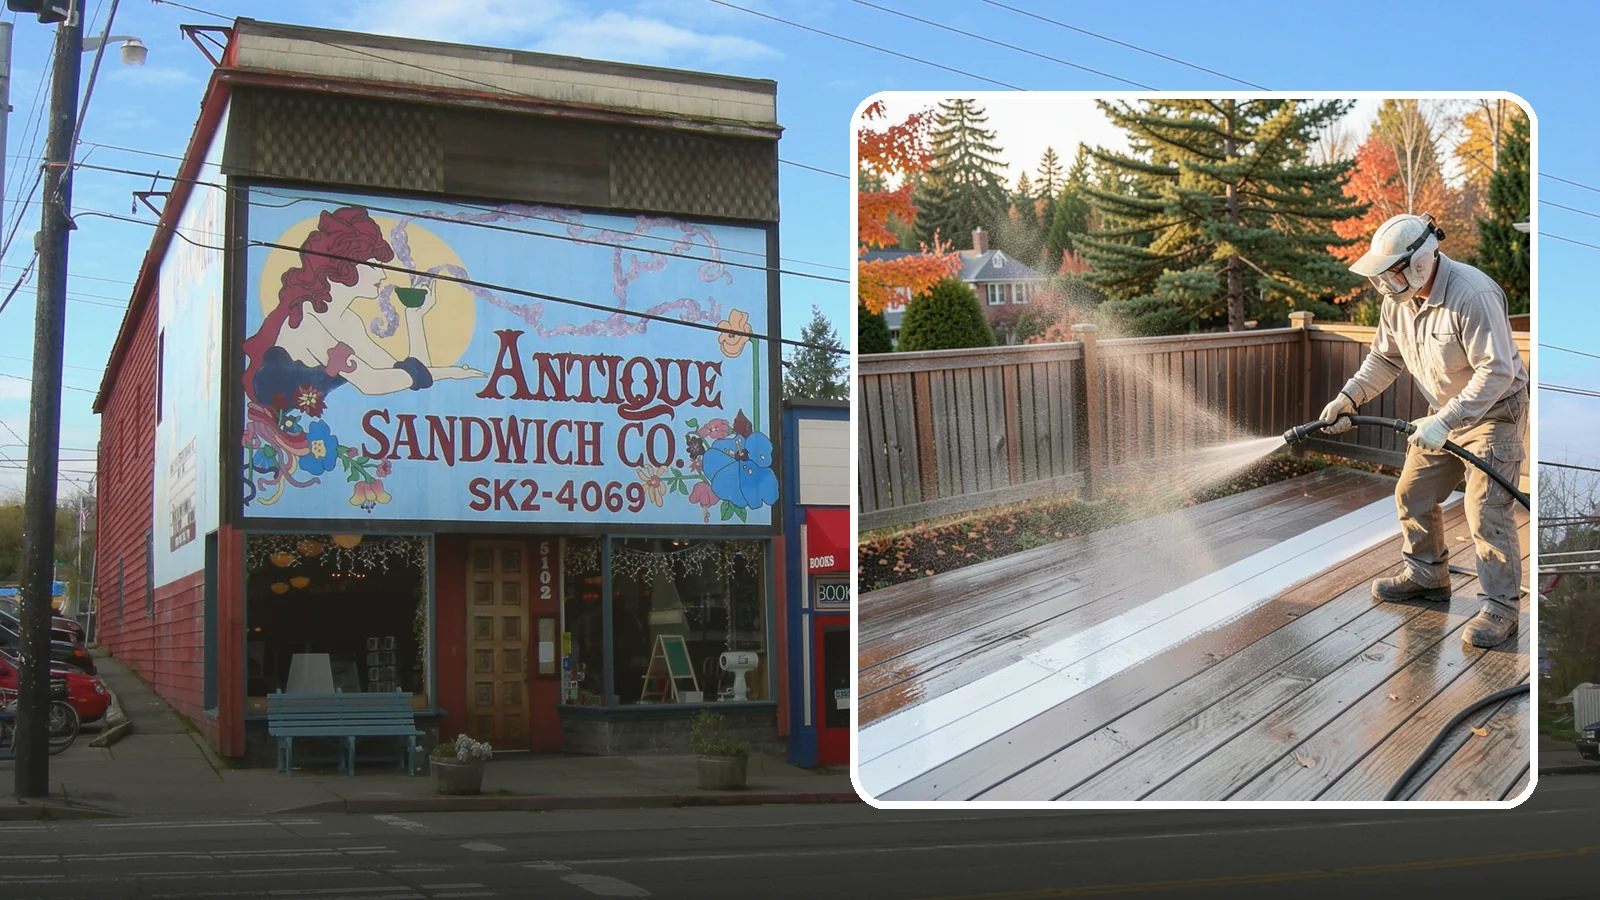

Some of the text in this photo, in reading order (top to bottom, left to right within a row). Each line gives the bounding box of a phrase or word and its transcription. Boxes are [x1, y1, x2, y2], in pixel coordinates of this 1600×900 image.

[475, 329, 723, 420] ANTIQUE
[362, 408, 685, 468] SANDWICH CO.
[468, 476, 646, 513] SK2-4069
[540, 541, 551, 600] 5102
[809, 555, 835, 569] BOOKS
